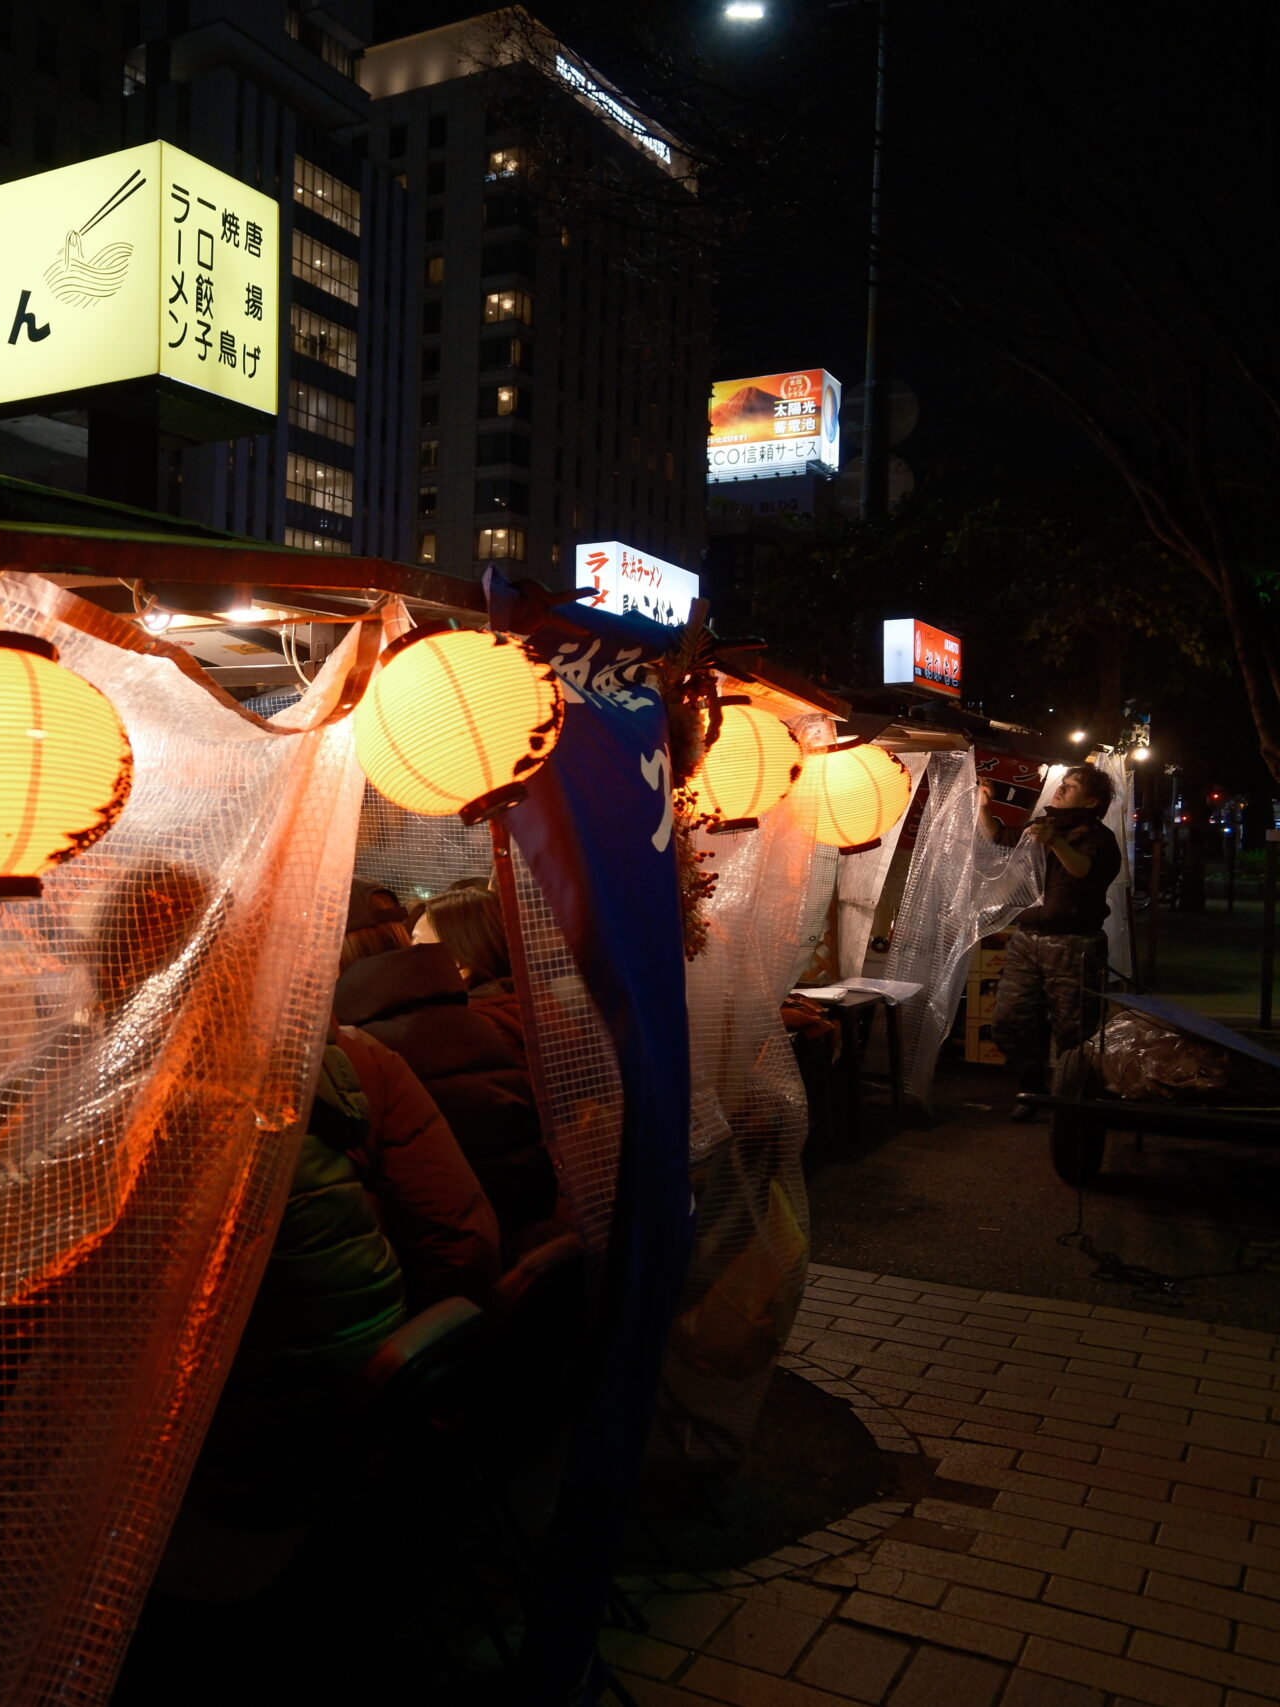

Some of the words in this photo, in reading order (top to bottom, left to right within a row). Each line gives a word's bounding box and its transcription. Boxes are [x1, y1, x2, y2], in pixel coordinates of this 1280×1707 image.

[168, 183, 189, 349] ラーメン
[194, 197, 217, 362] 一口餃子
[218, 208, 240, 369] 焼鳥
[242, 220, 263, 379] 唐揚げ
[773, 418, 816, 434] 蓄電池
[774, 401, 816, 417] 太陽光
